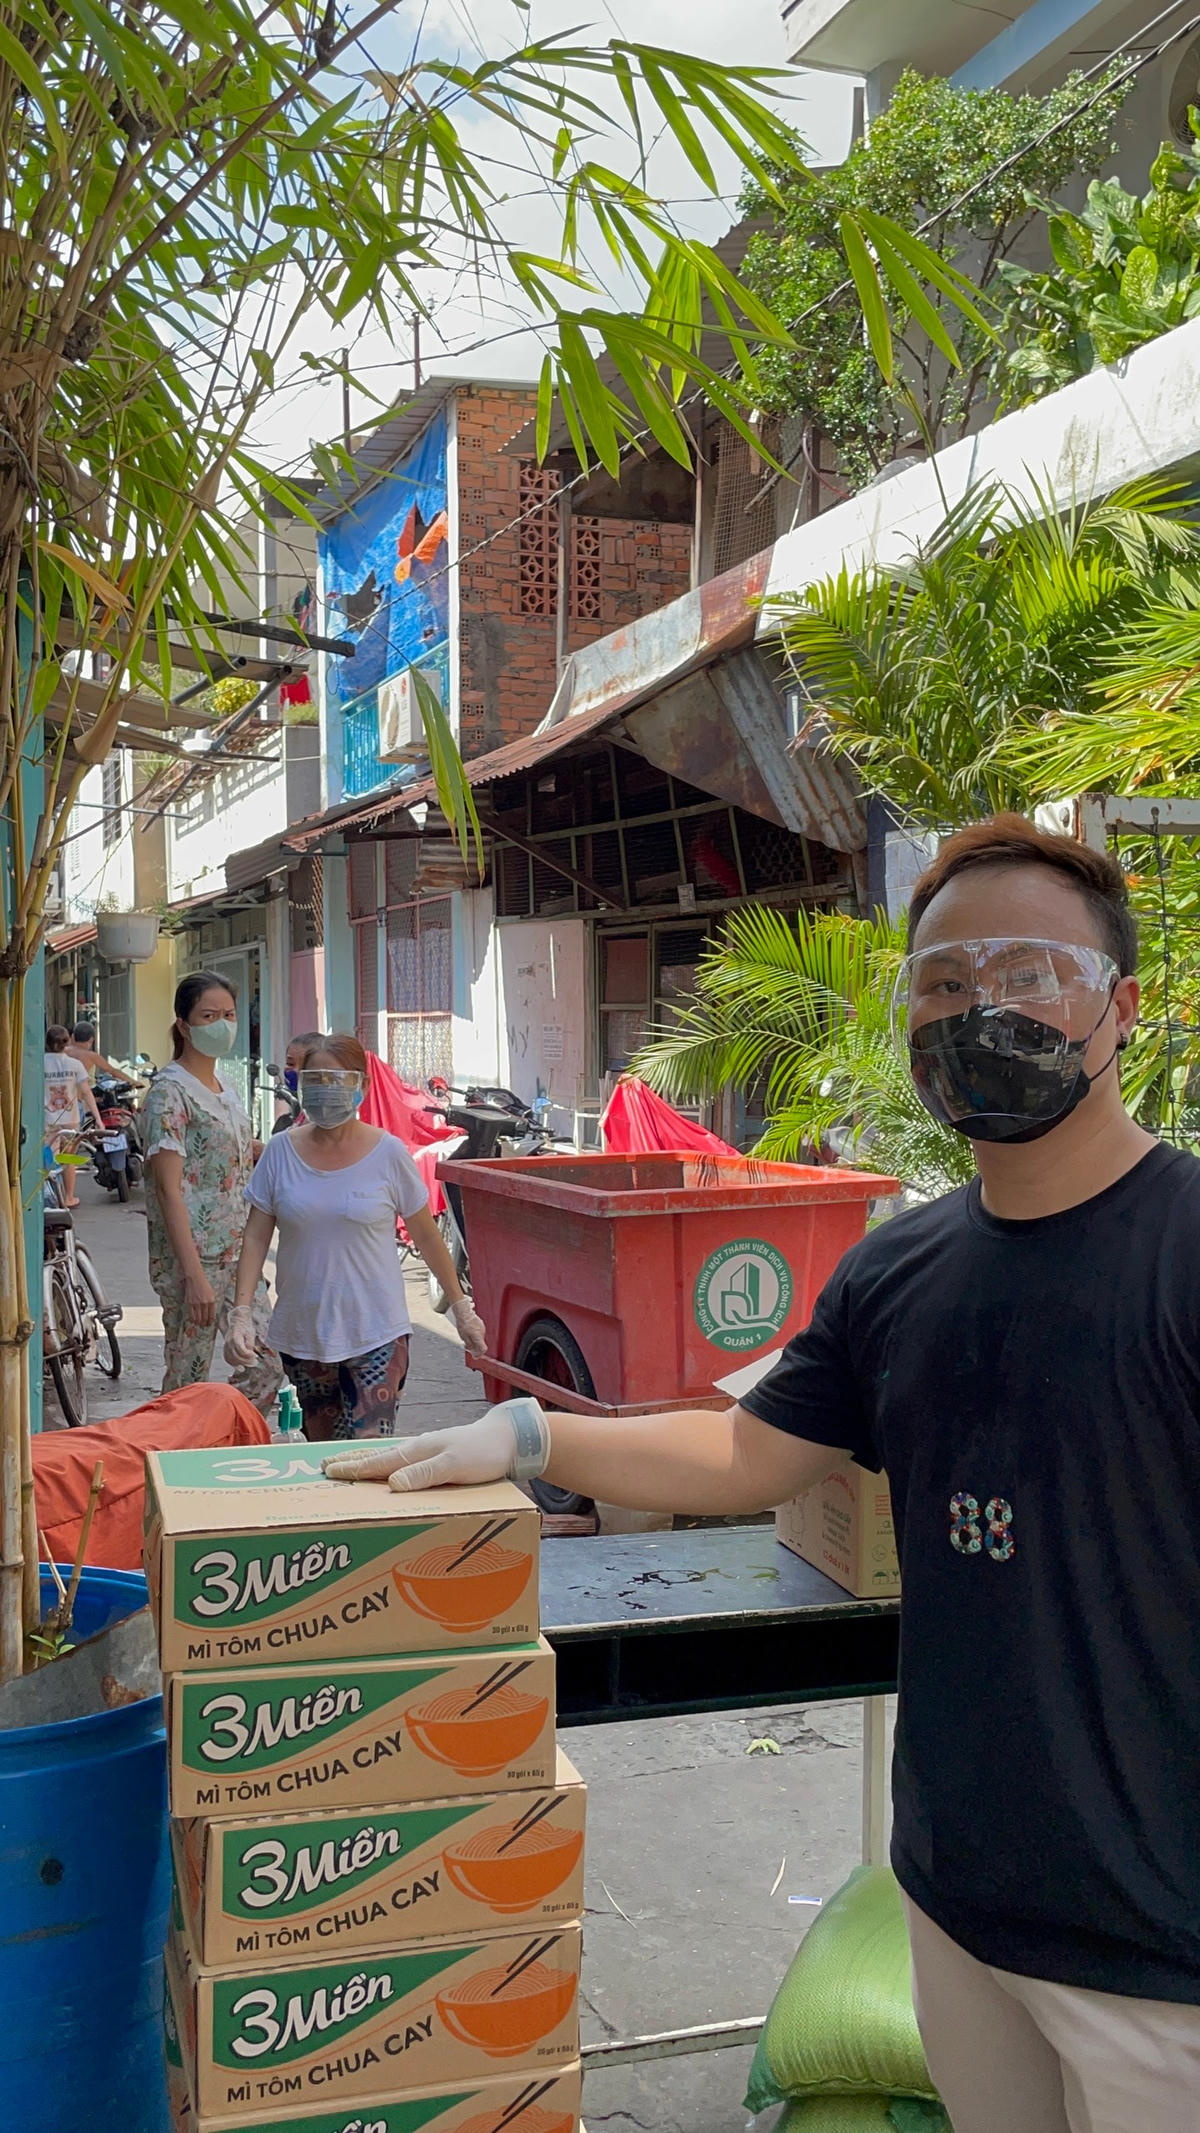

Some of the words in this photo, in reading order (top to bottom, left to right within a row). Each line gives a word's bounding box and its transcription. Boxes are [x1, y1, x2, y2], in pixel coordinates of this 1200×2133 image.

[698, 1271, 712, 1294] TNHH
[949, 1491, 1015, 1562] 88
[187, 1639, 211, 1660] MÌ
[216, 1636, 261, 1657] TÔM
[267, 1614, 338, 1647] CHUA
[341, 1585, 392, 1624] CAY
[196, 1783, 220, 1804] MÌ
[225, 1781, 271, 1802] TÔM
[277, 1759, 350, 1793] CHUA
[352, 1729, 403, 1768] CAY
[236, 1931, 260, 1952] MÌ
[265, 1927, 310, 1948] TÔM
[316, 1901, 388, 1936] CHUA
[391, 1870, 441, 1909] CAY
[227, 2081, 251, 2102] MÌ
[256, 2074, 302, 2098] TÔM
[308, 2048, 380, 2085] CHUA
[384, 2014, 434, 2056] CAY
